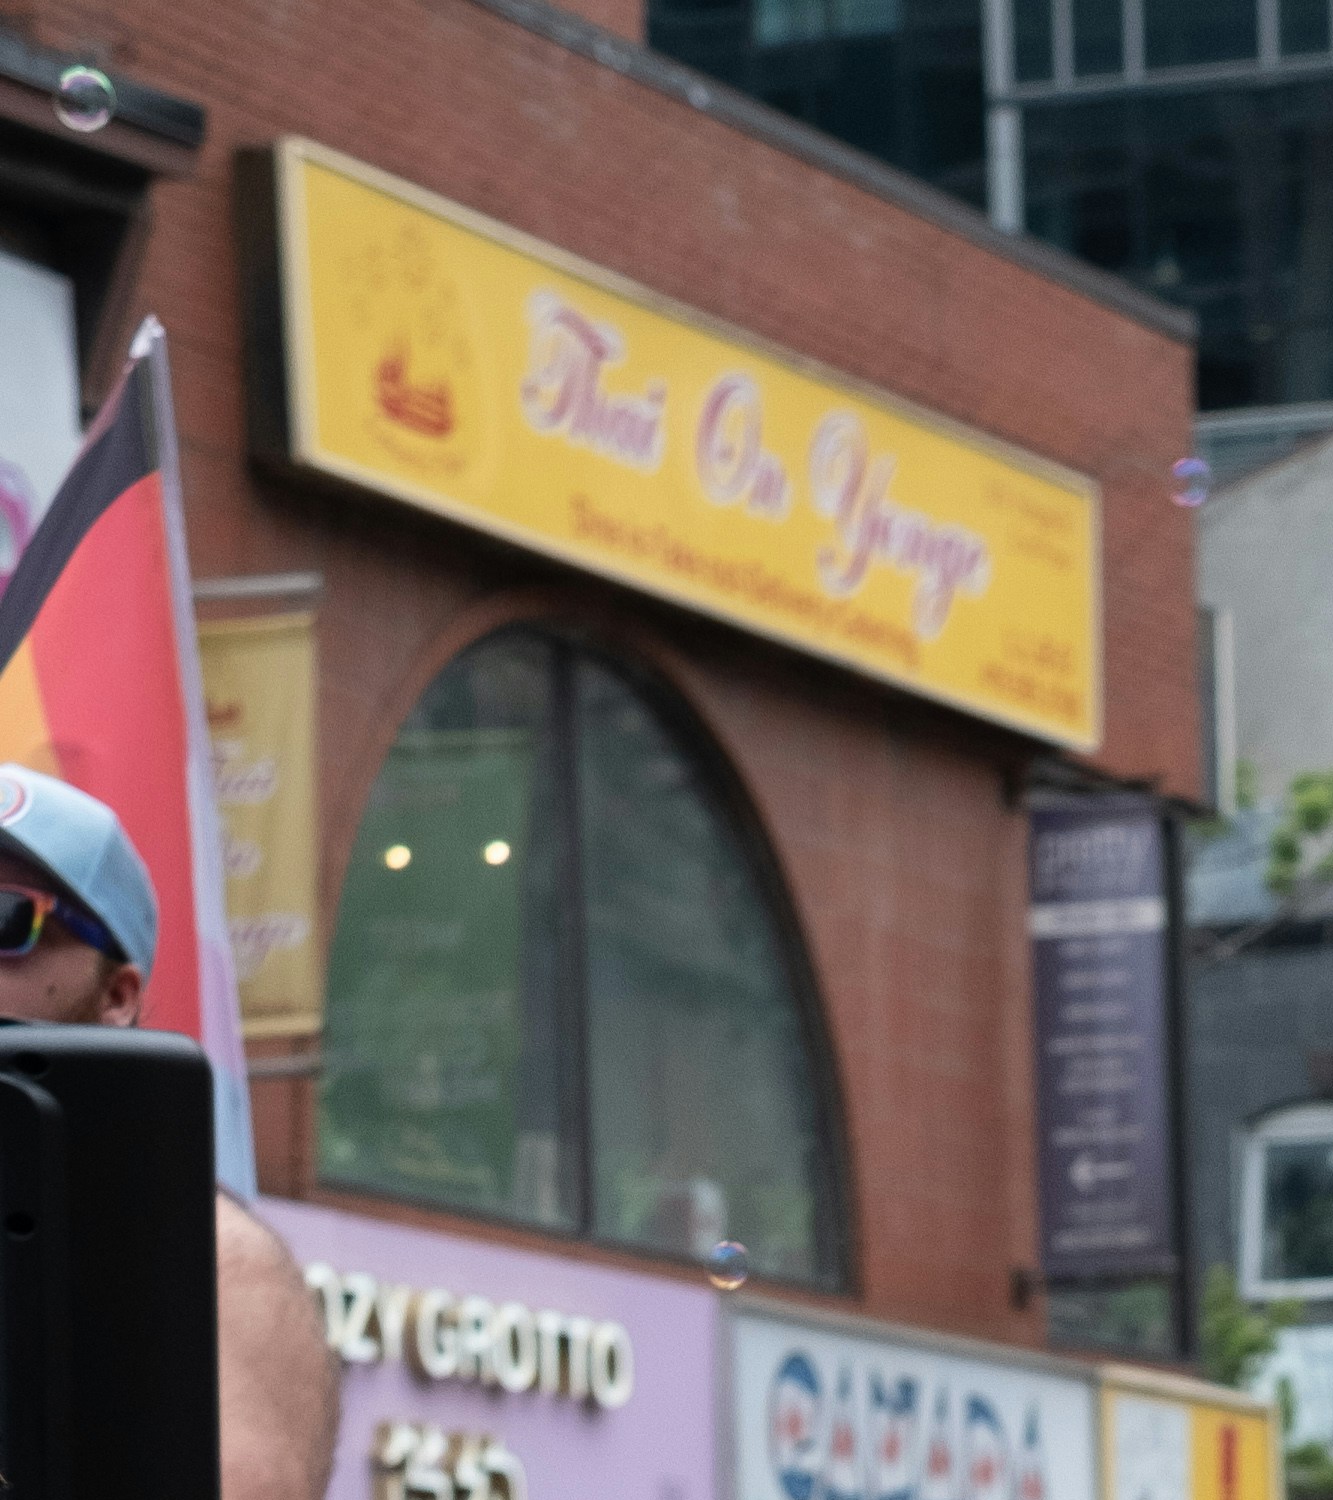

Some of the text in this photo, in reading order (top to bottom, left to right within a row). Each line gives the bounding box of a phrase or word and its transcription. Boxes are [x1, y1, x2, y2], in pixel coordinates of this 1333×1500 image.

[520, 283, 668, 476] Thai
[694, 368, 793, 524] On
[808, 408, 992, 643] Yonge
[414, 1286, 637, 1411] GROTTO
